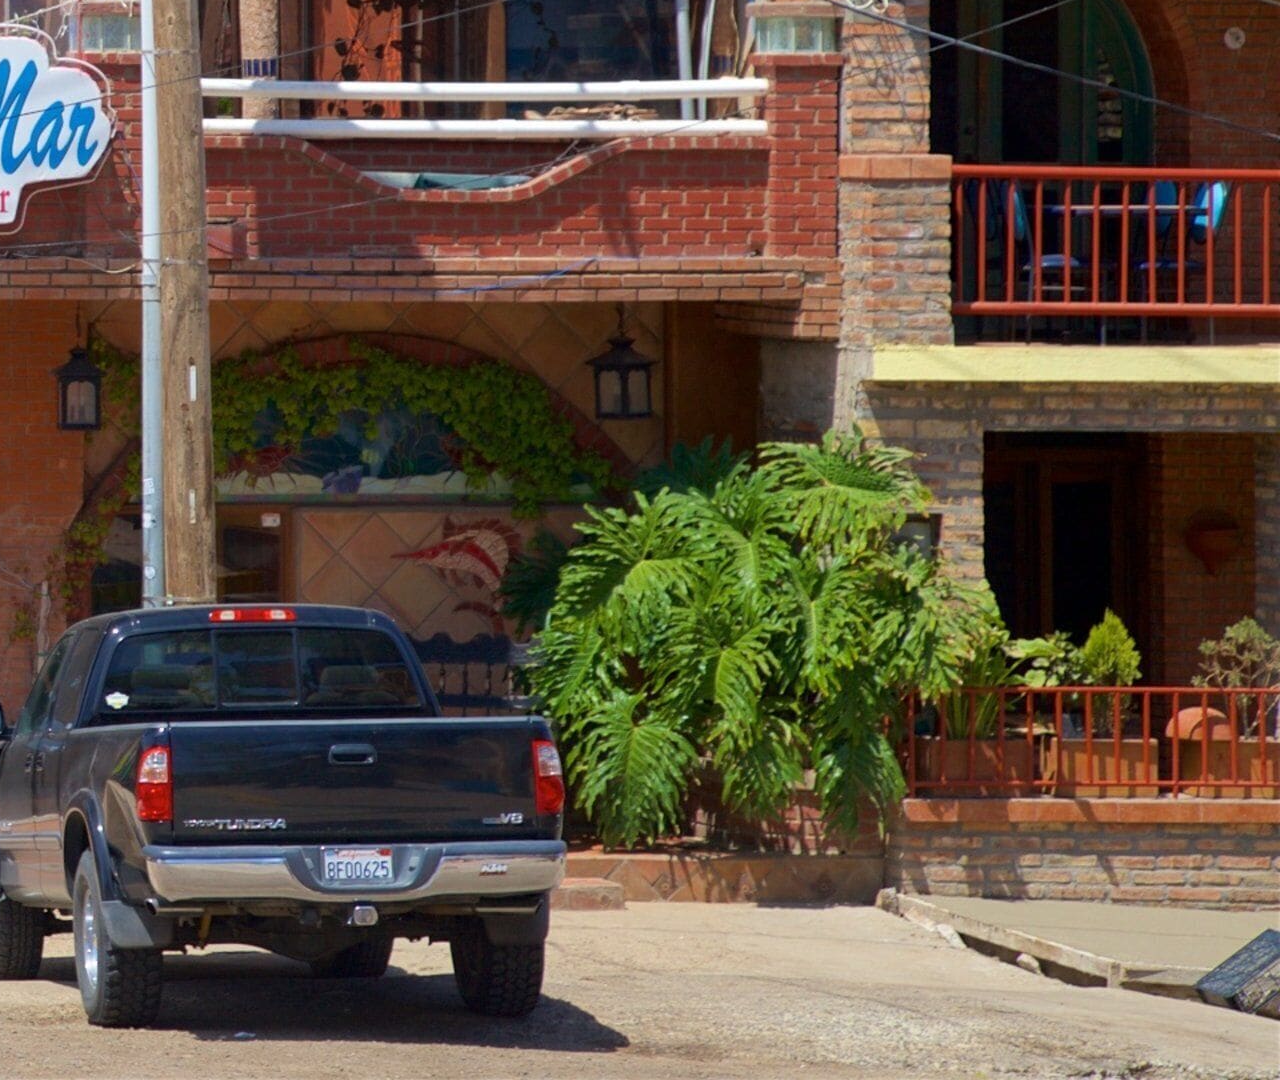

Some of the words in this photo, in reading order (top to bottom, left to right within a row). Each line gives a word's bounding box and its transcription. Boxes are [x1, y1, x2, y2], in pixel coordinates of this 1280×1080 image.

[214, 818, 287, 830] TUNDRA
[500, 812, 523, 825] V8
[327, 860, 389, 879] 8F00625
